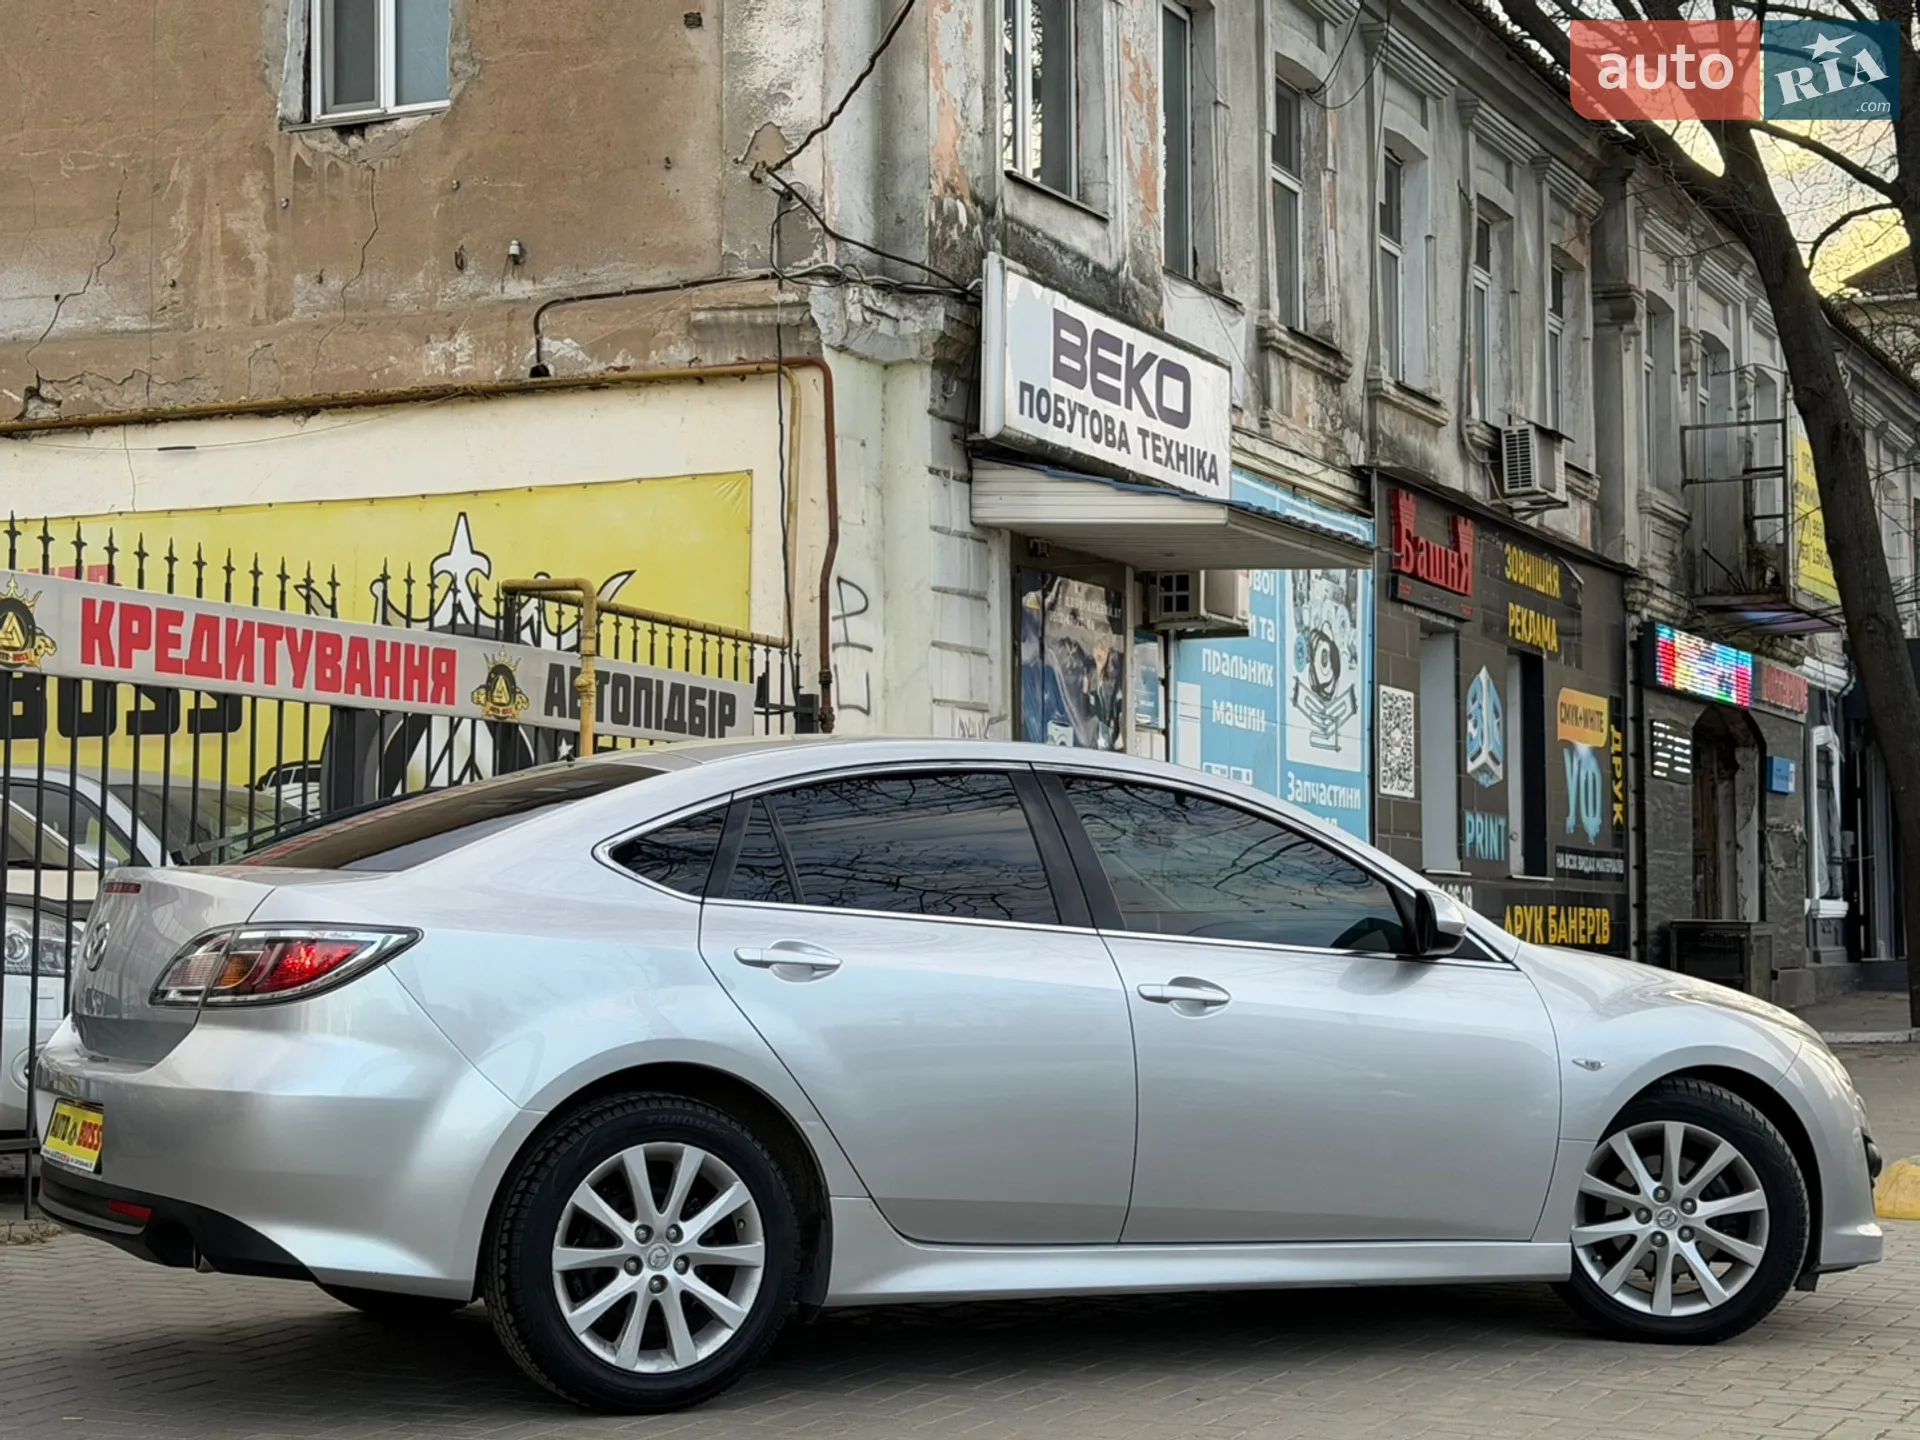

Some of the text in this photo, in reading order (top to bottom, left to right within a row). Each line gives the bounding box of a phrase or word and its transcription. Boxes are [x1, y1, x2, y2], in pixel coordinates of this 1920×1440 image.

[1053, 308, 1191, 429] BEKO
[1019, 381, 1219, 486] ПОБУТОВА ТЕХНІКА
[1504, 543, 1561, 599] ЗОВНІШНЯ
[81, 597, 457, 706] КРЕДИТУВАННЯ
[1508, 602, 1558, 652] РЕКЛАМА
[1201, 648, 1274, 687] пральних
[1212, 700, 1266, 733] машин
[1287, 770, 1361, 811] Запчастини
[1610, 724, 1624, 827] ДРУК
[1466, 811, 1506, 861] PRINT
[1548, 905, 1610, 945] БАНЕРІВ
